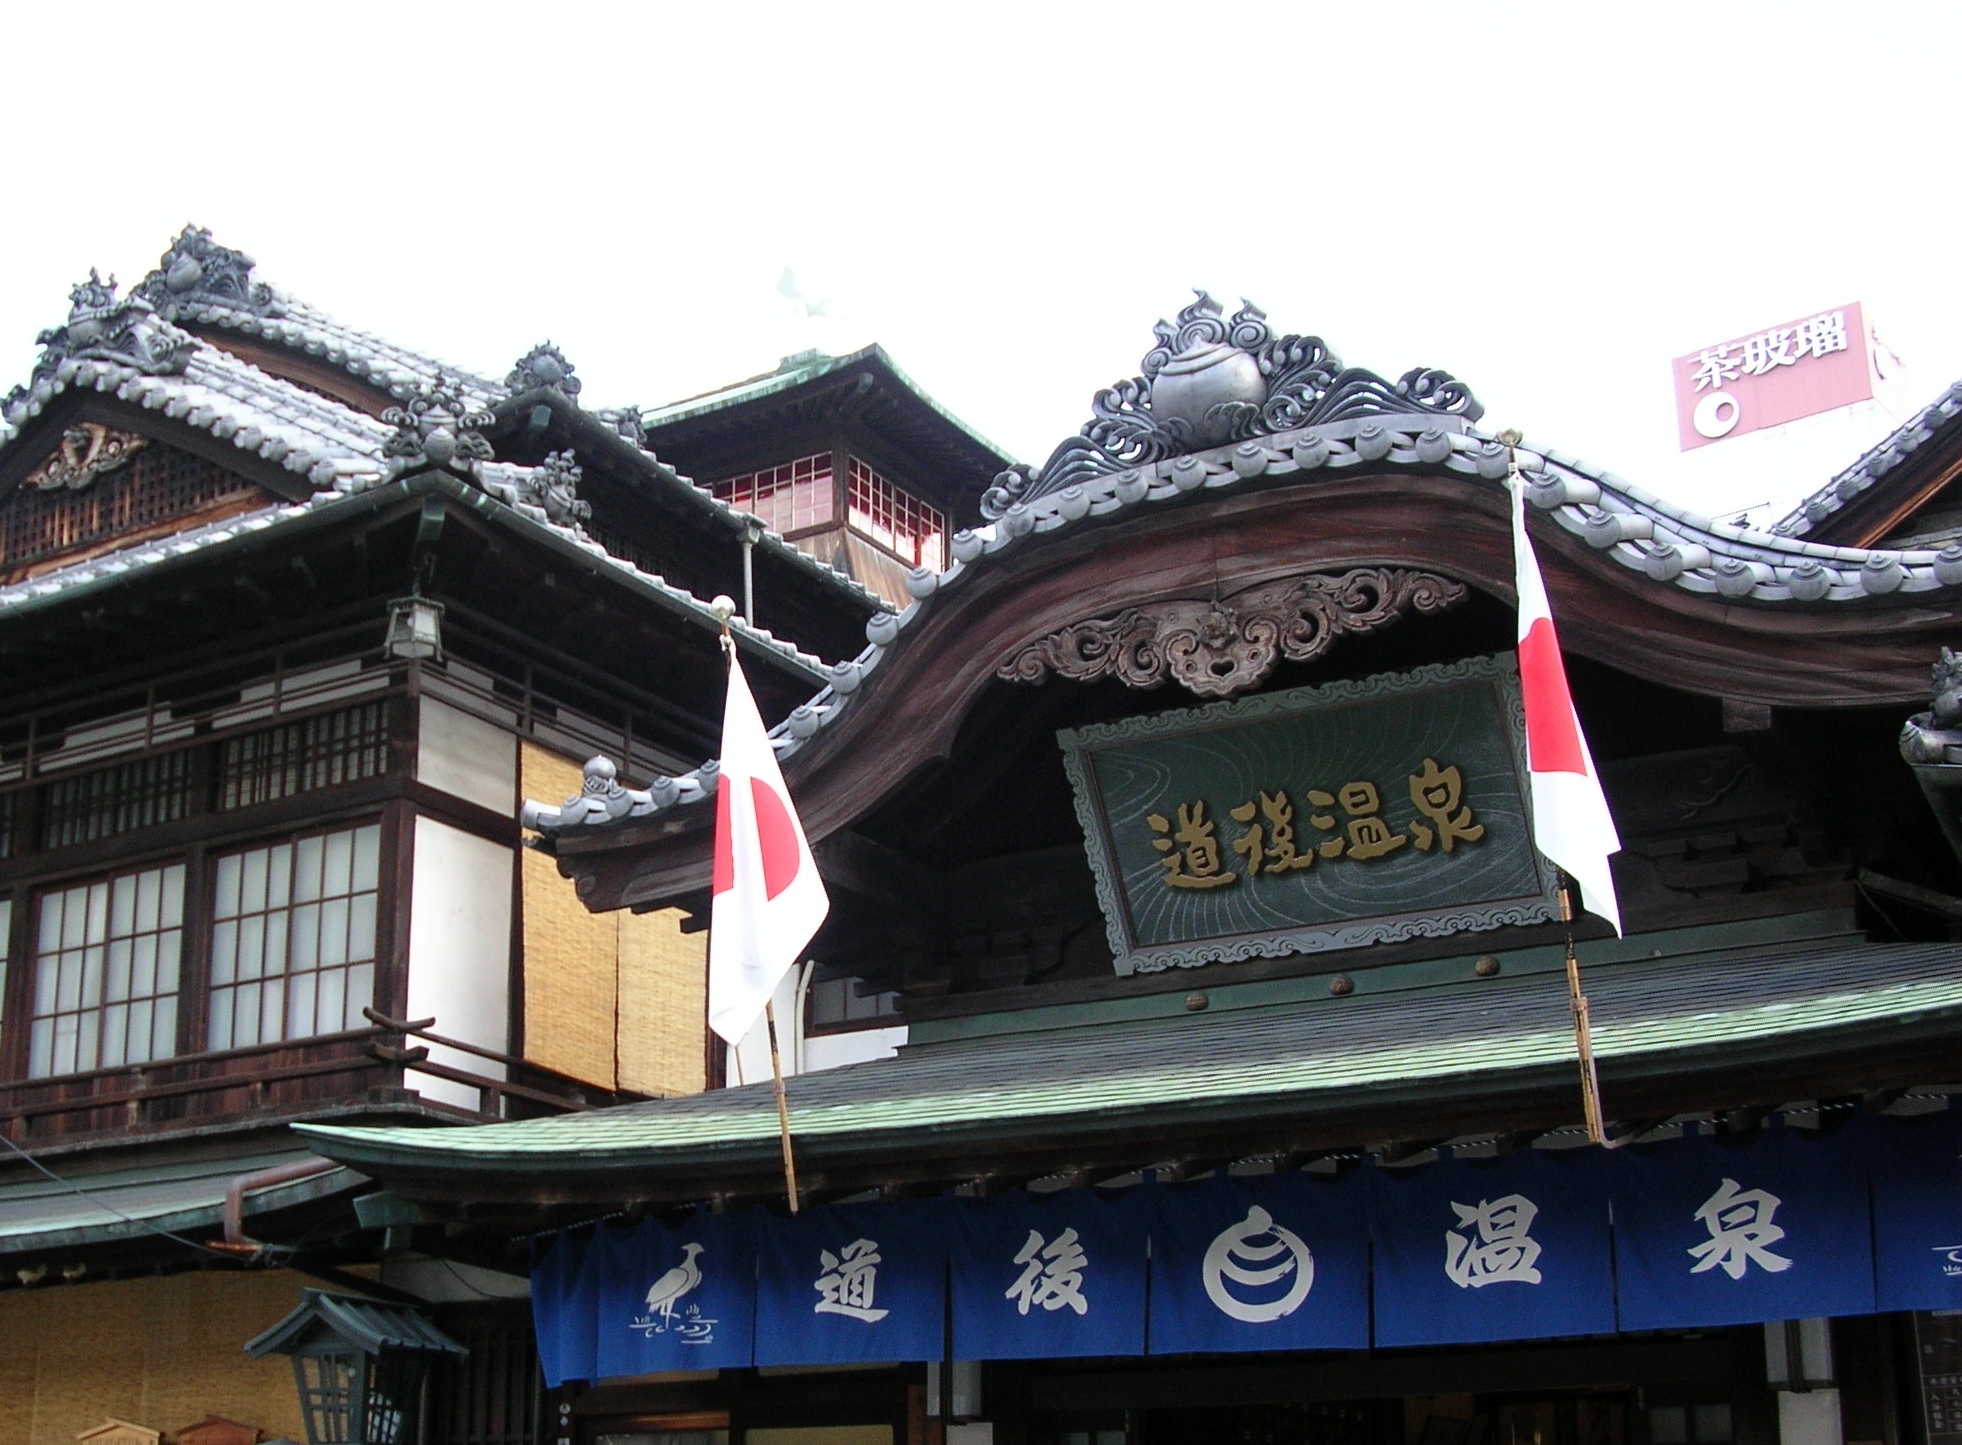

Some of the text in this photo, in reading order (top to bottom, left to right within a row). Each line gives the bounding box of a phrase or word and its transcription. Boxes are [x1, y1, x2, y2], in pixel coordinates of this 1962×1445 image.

[1687, 311, 1848, 394] 茶玻瑠
[1147, 757, 1485, 889] 道後温泉
